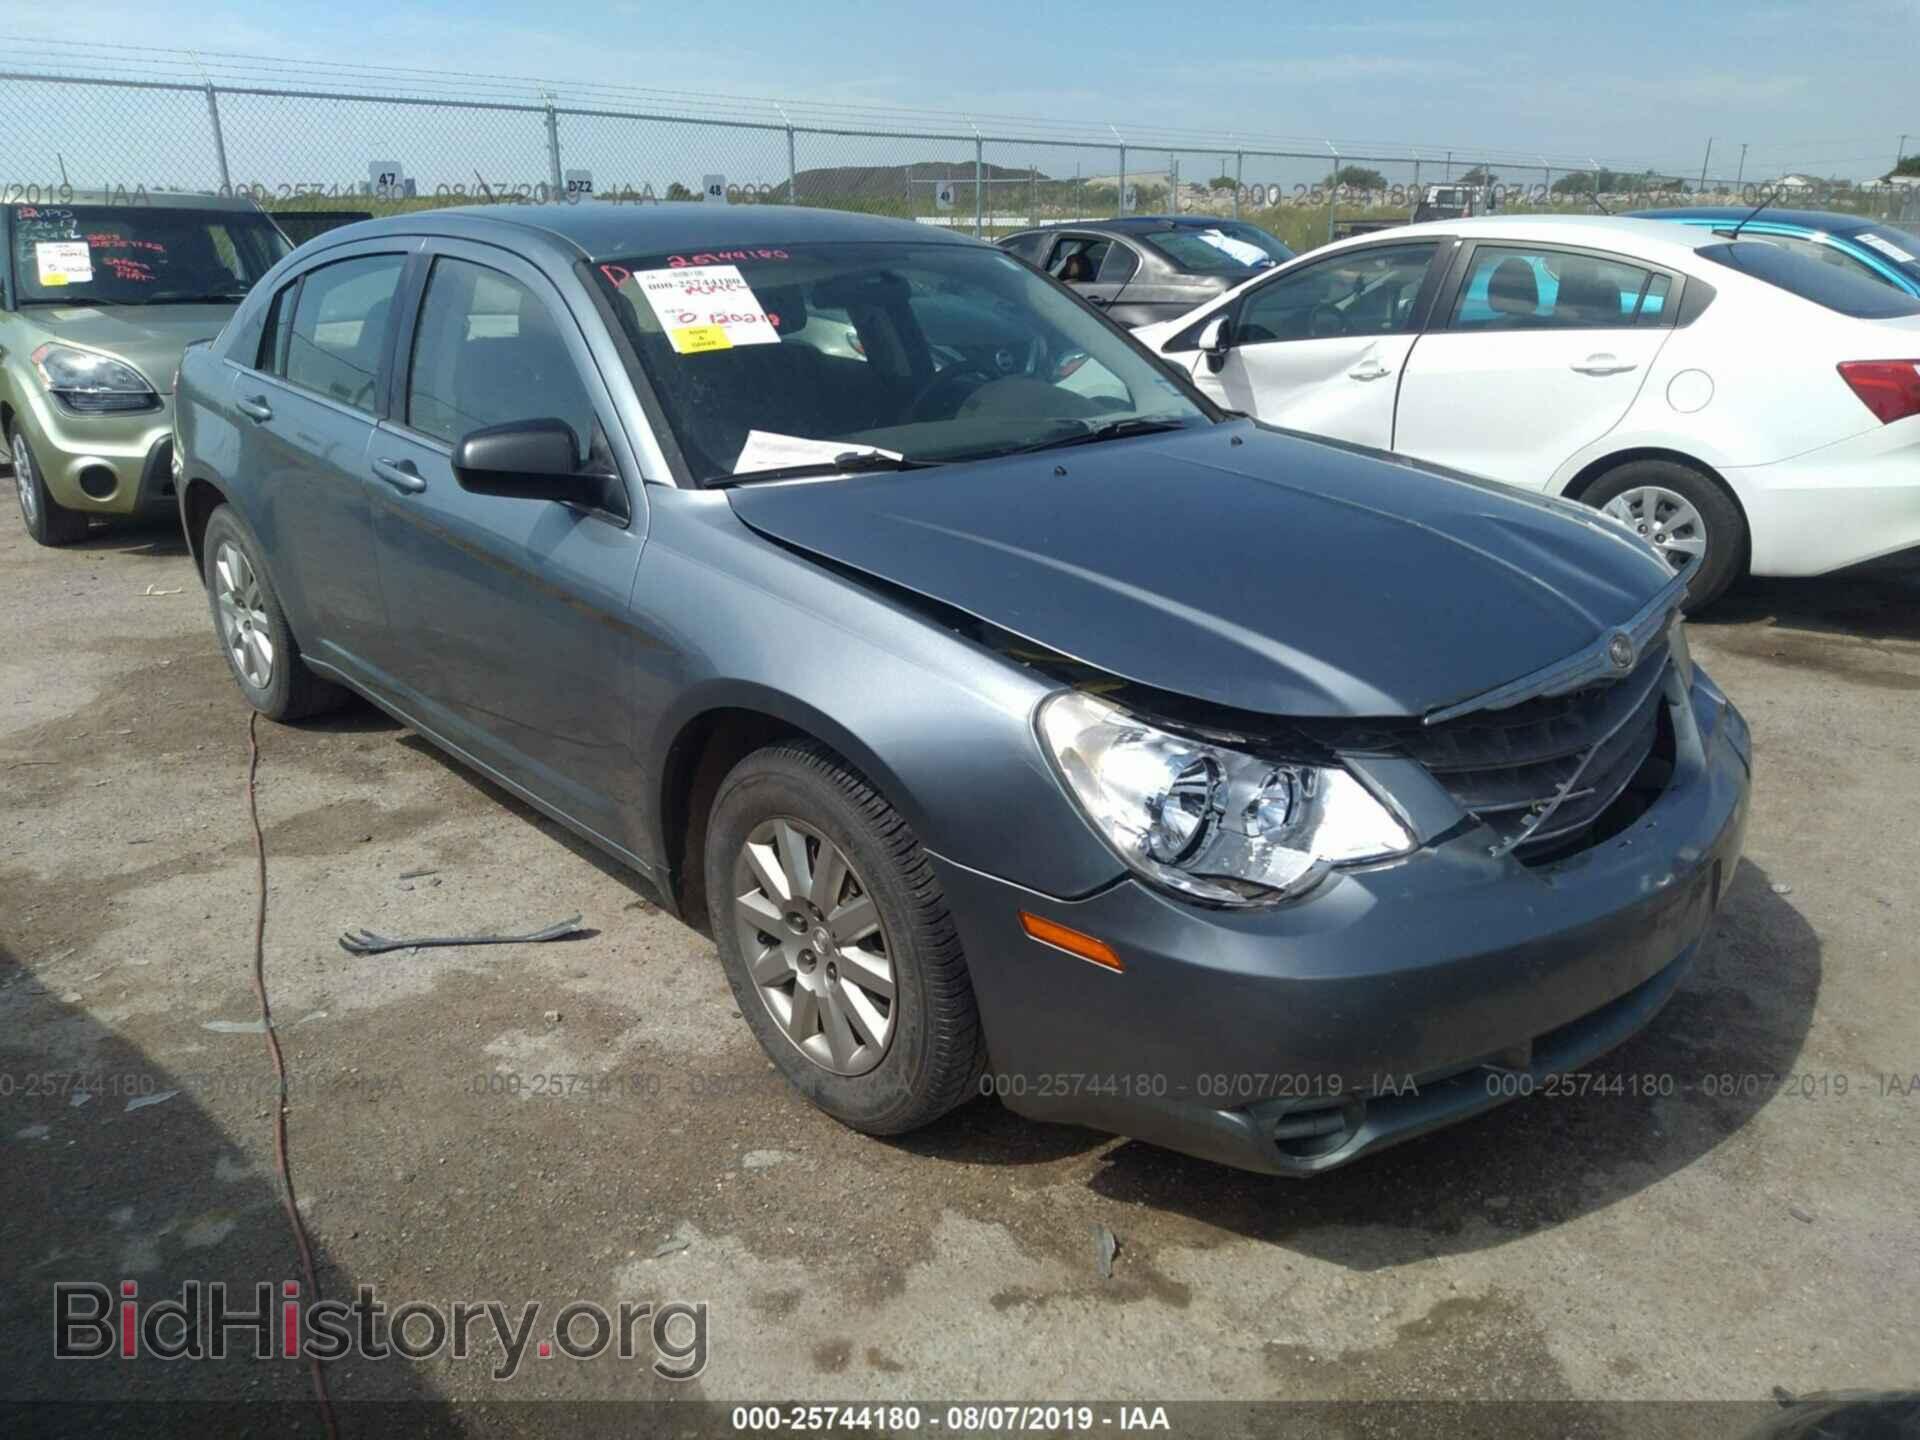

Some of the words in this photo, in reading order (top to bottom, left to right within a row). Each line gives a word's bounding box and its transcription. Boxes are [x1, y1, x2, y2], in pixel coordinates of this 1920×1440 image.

[378, 172, 396, 186] 47
[568, 180, 593, 194] DZ2
[708, 184, 722, 198] 48
[600, 264, 631, 289] D
